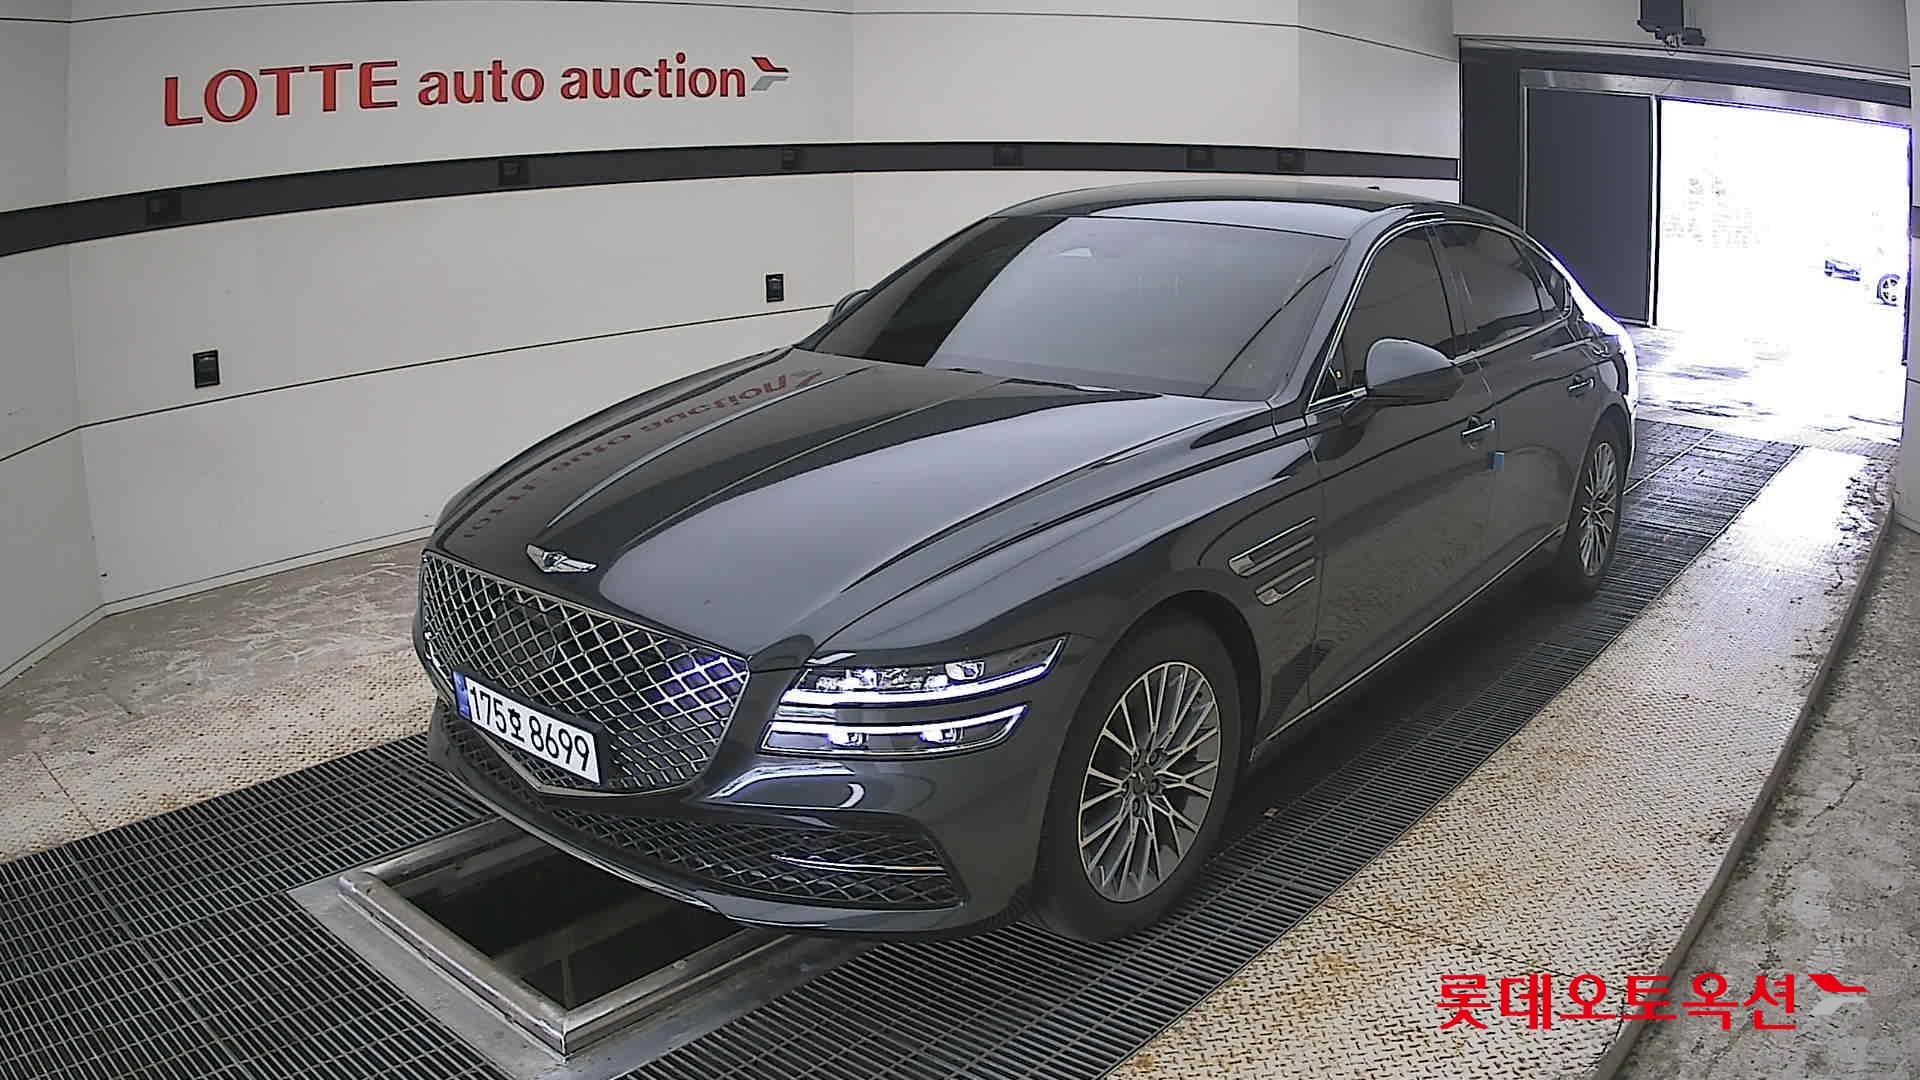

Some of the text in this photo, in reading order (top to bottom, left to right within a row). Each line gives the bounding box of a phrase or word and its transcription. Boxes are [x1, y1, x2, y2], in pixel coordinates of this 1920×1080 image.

[164, 52, 747, 126] LOTTE auto auction
[469, 686, 590, 772] 175호 8699
